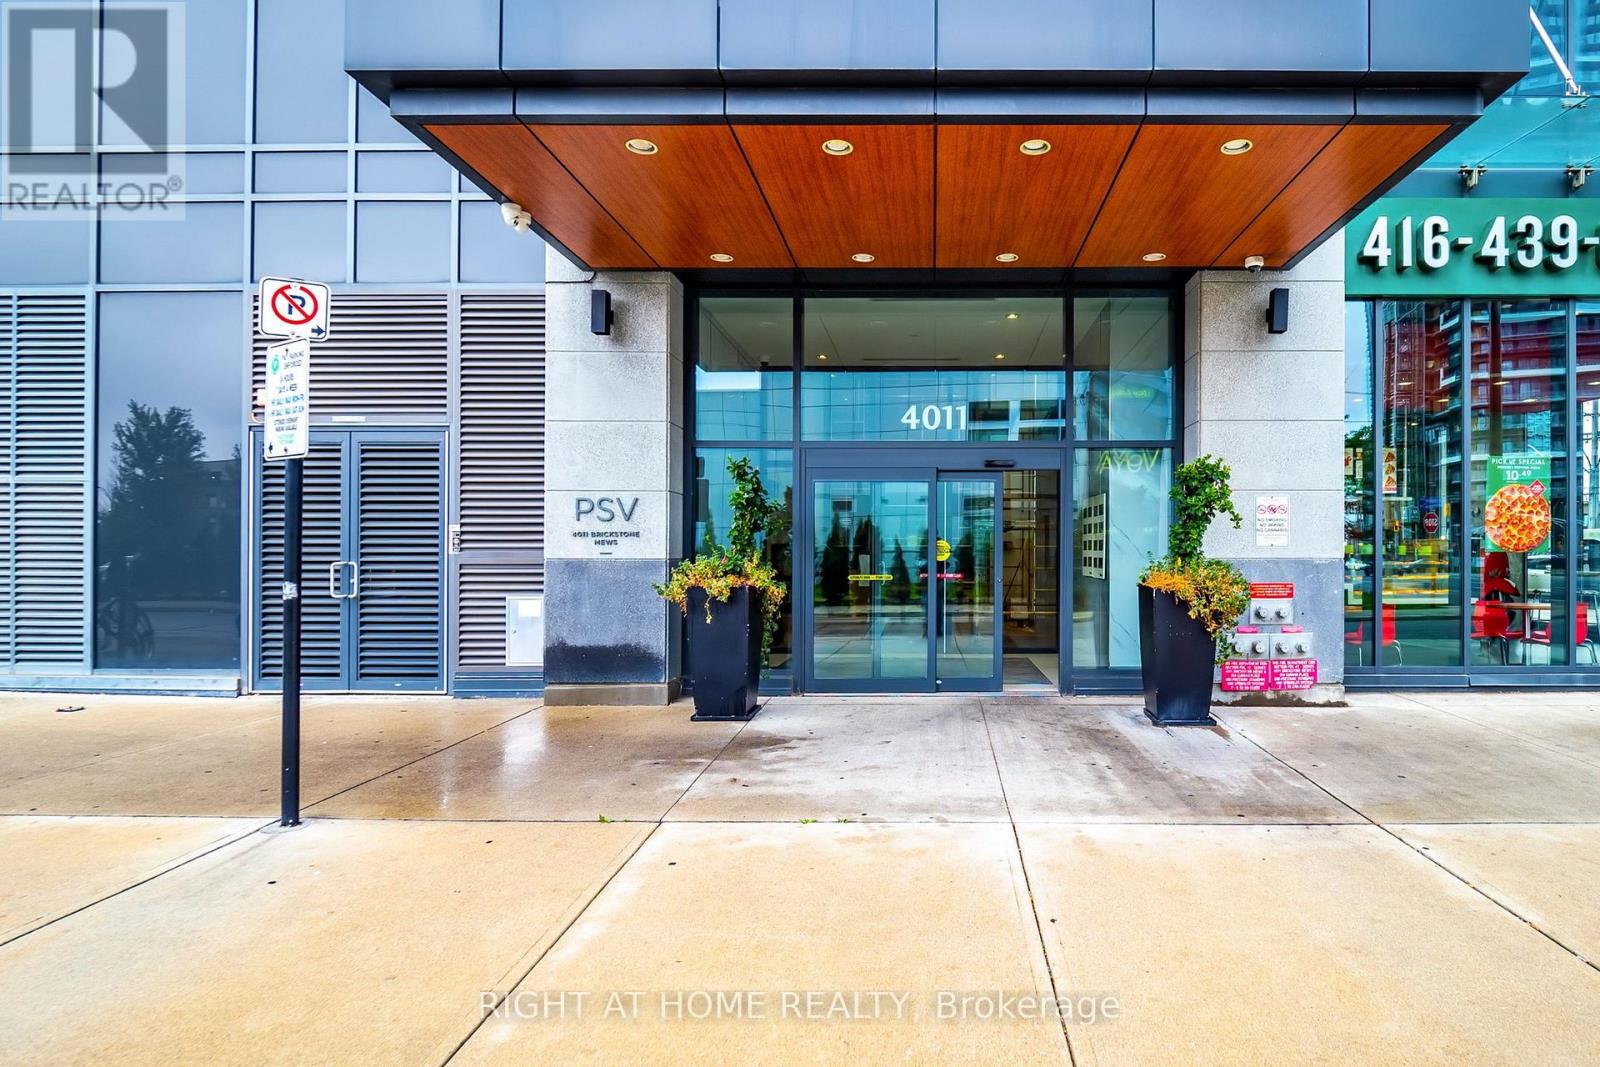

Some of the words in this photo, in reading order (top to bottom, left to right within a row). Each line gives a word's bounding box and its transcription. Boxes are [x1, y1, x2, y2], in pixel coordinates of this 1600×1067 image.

[1362, 214, 1600, 269] 416-439-
[900, 404, 967, 431] 4011
[575, 496, 640, 522] PSV
